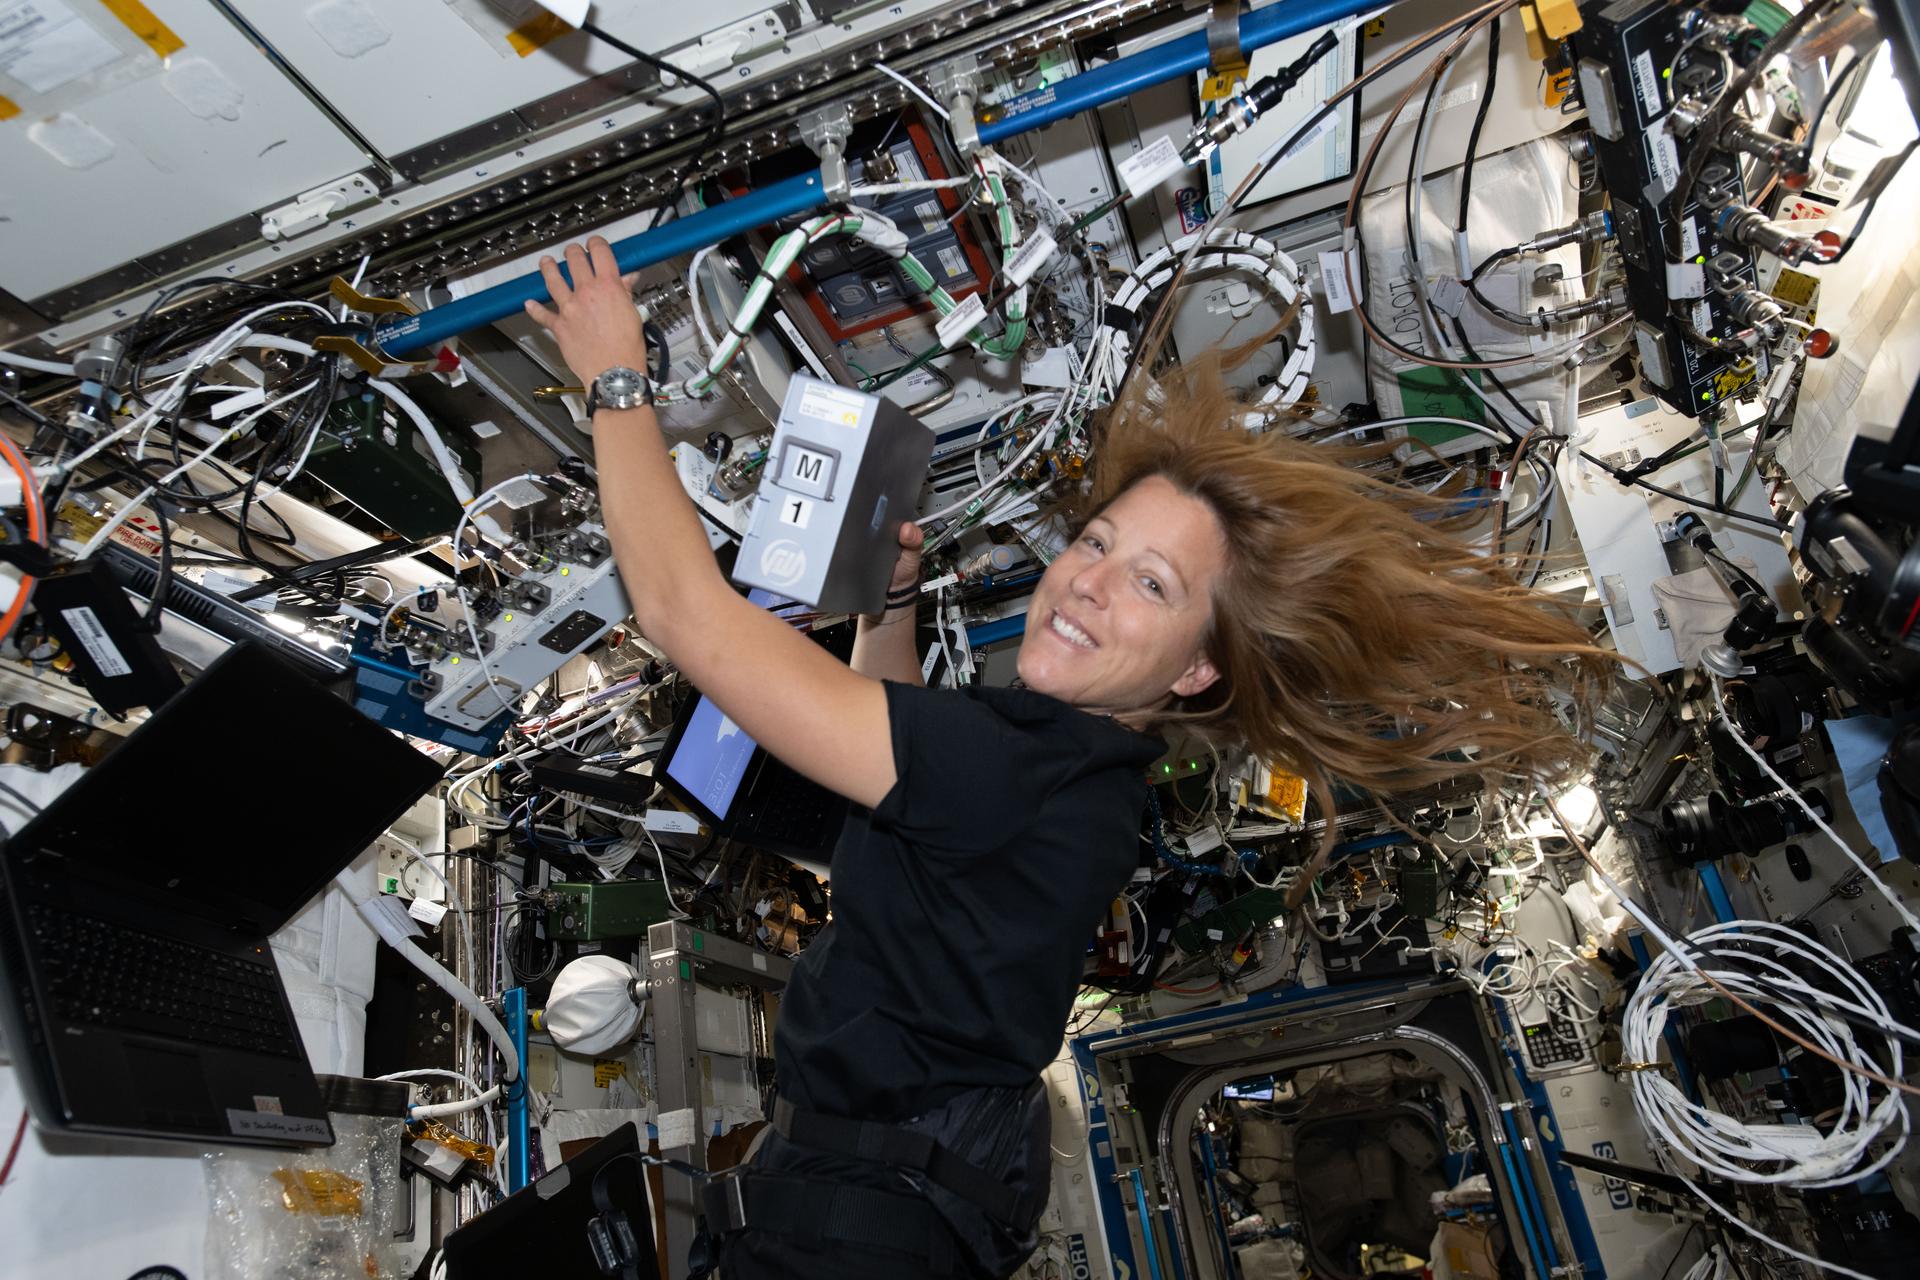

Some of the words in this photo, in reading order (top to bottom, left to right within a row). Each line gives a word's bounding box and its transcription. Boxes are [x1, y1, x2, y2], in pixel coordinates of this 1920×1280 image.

[738, 67, 752, 80] G
[602, 118, 617, 130] H
[342, 219, 356, 231] K
[848, 236, 865, 248] 3
[875, 281, 891, 290] 4
[1689, 359, 1699, 375] 120
[796, 454, 823, 482] M
[791, 500, 803, 524] 1
[116, 525, 134, 540] FIRE
[134, 535, 156, 550] PORT
[1593, 1144, 1631, 1206] SBD
[1069, 1236, 1090, 1280] ORT
